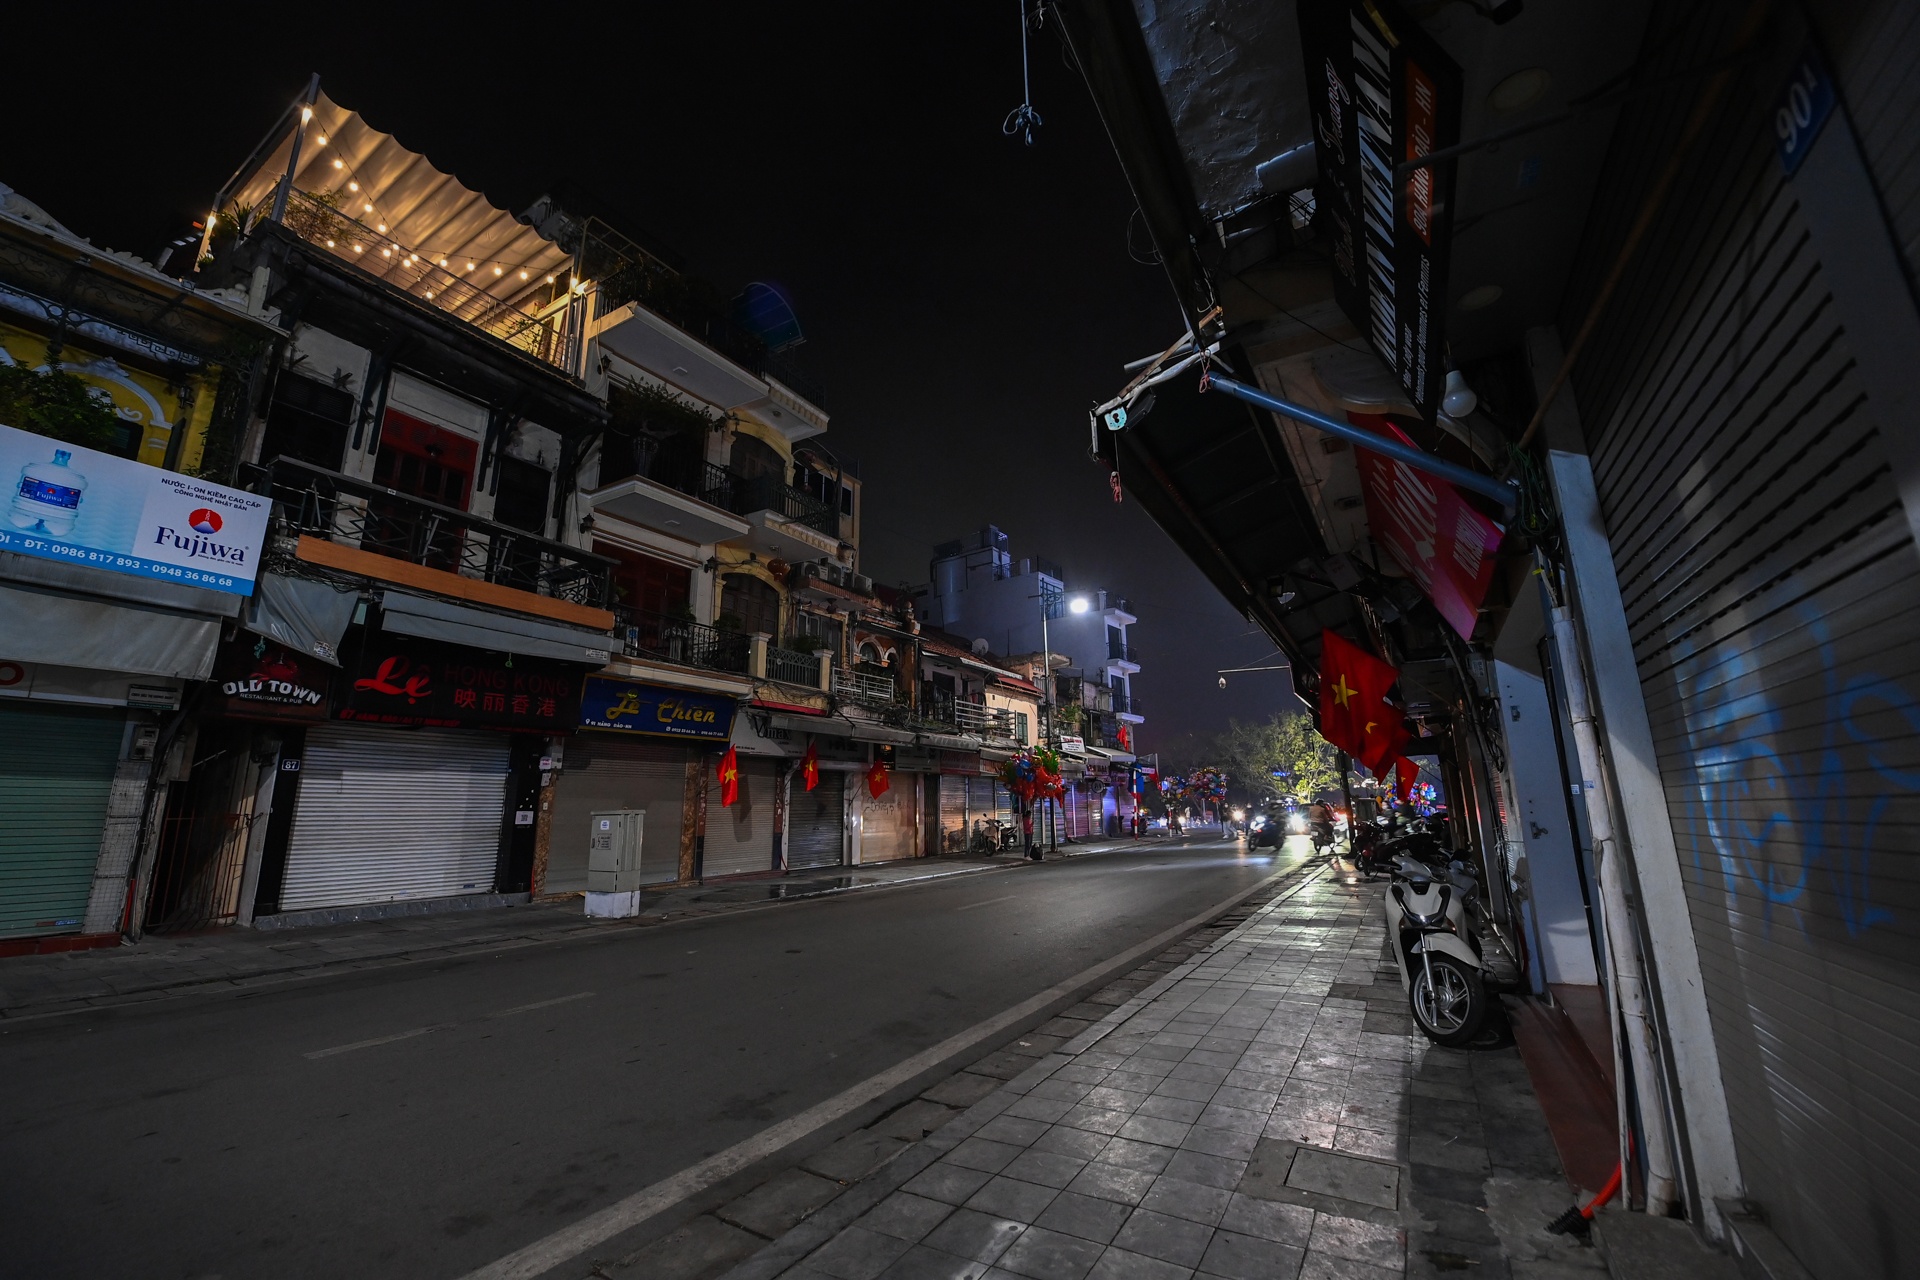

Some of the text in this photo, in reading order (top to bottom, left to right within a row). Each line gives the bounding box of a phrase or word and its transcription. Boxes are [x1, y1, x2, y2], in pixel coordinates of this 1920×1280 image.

[1316, 57, 1350, 165] Trung
[1414, 78, 1431, 116] HN
[1349, 8, 1398, 373] MADE IN VIETNAM
[1413, 202, 1428, 236] 90A
[161, 478, 186, 489] NƯỚC
[187, 484, 206, 495] I-ON
[228, 495, 244, 505] CAO
[245, 500, 262, 509] CẤP
[173, 488, 194, 498] CÔNG
[153, 525, 244, 563] Fujiwa
[24, 538, 49, 551] ĐT:
[51, 544, 86, 558] 0986
[88, 551, 114, 564] 817
[116, 557, 141, 569] 893
[151, 564, 182, 577] 0948
[184, 570, 199, 580] 36
[201, 574, 216, 584] 86
[218, 577, 233, 587] 68
[222, 679, 322, 705] OLD TOWN
[240, 692, 282, 702] RESTAURANT
[442, 662, 507, 690] HONG
[513, 671, 570, 698] KONG
[454, 688, 556, 717] 映丽香港
